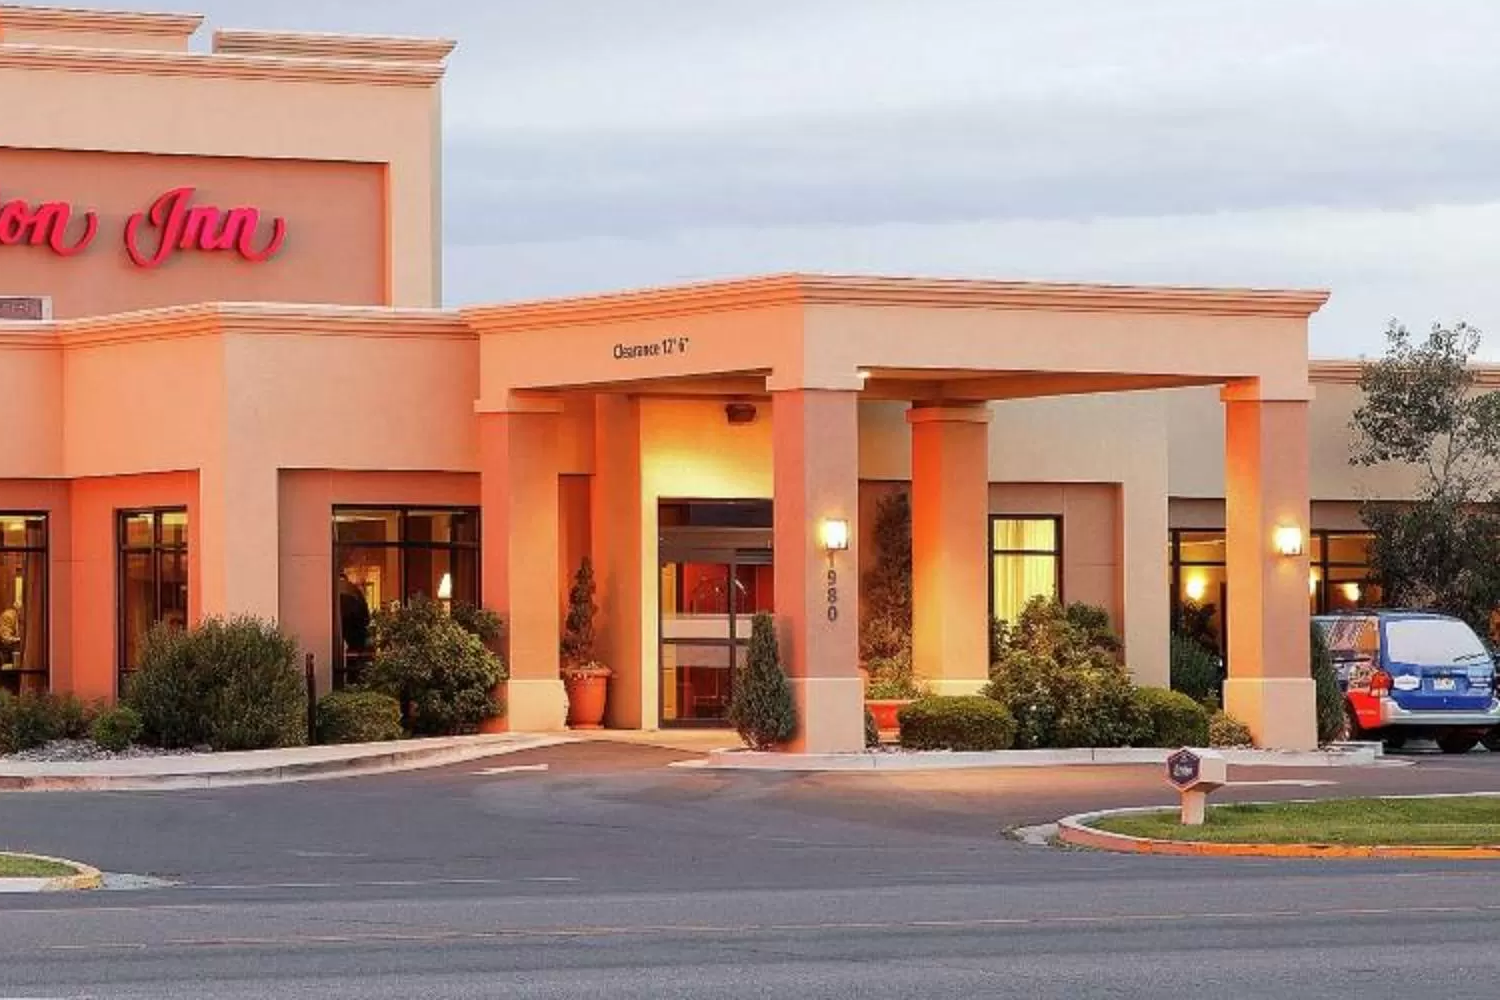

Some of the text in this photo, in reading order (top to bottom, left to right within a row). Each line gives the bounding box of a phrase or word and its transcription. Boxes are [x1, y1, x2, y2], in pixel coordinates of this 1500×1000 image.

[124, 186, 287, 269] Inn
[613, 343, 660, 360] Clearance
[827, 550, 837, 622] 1980
